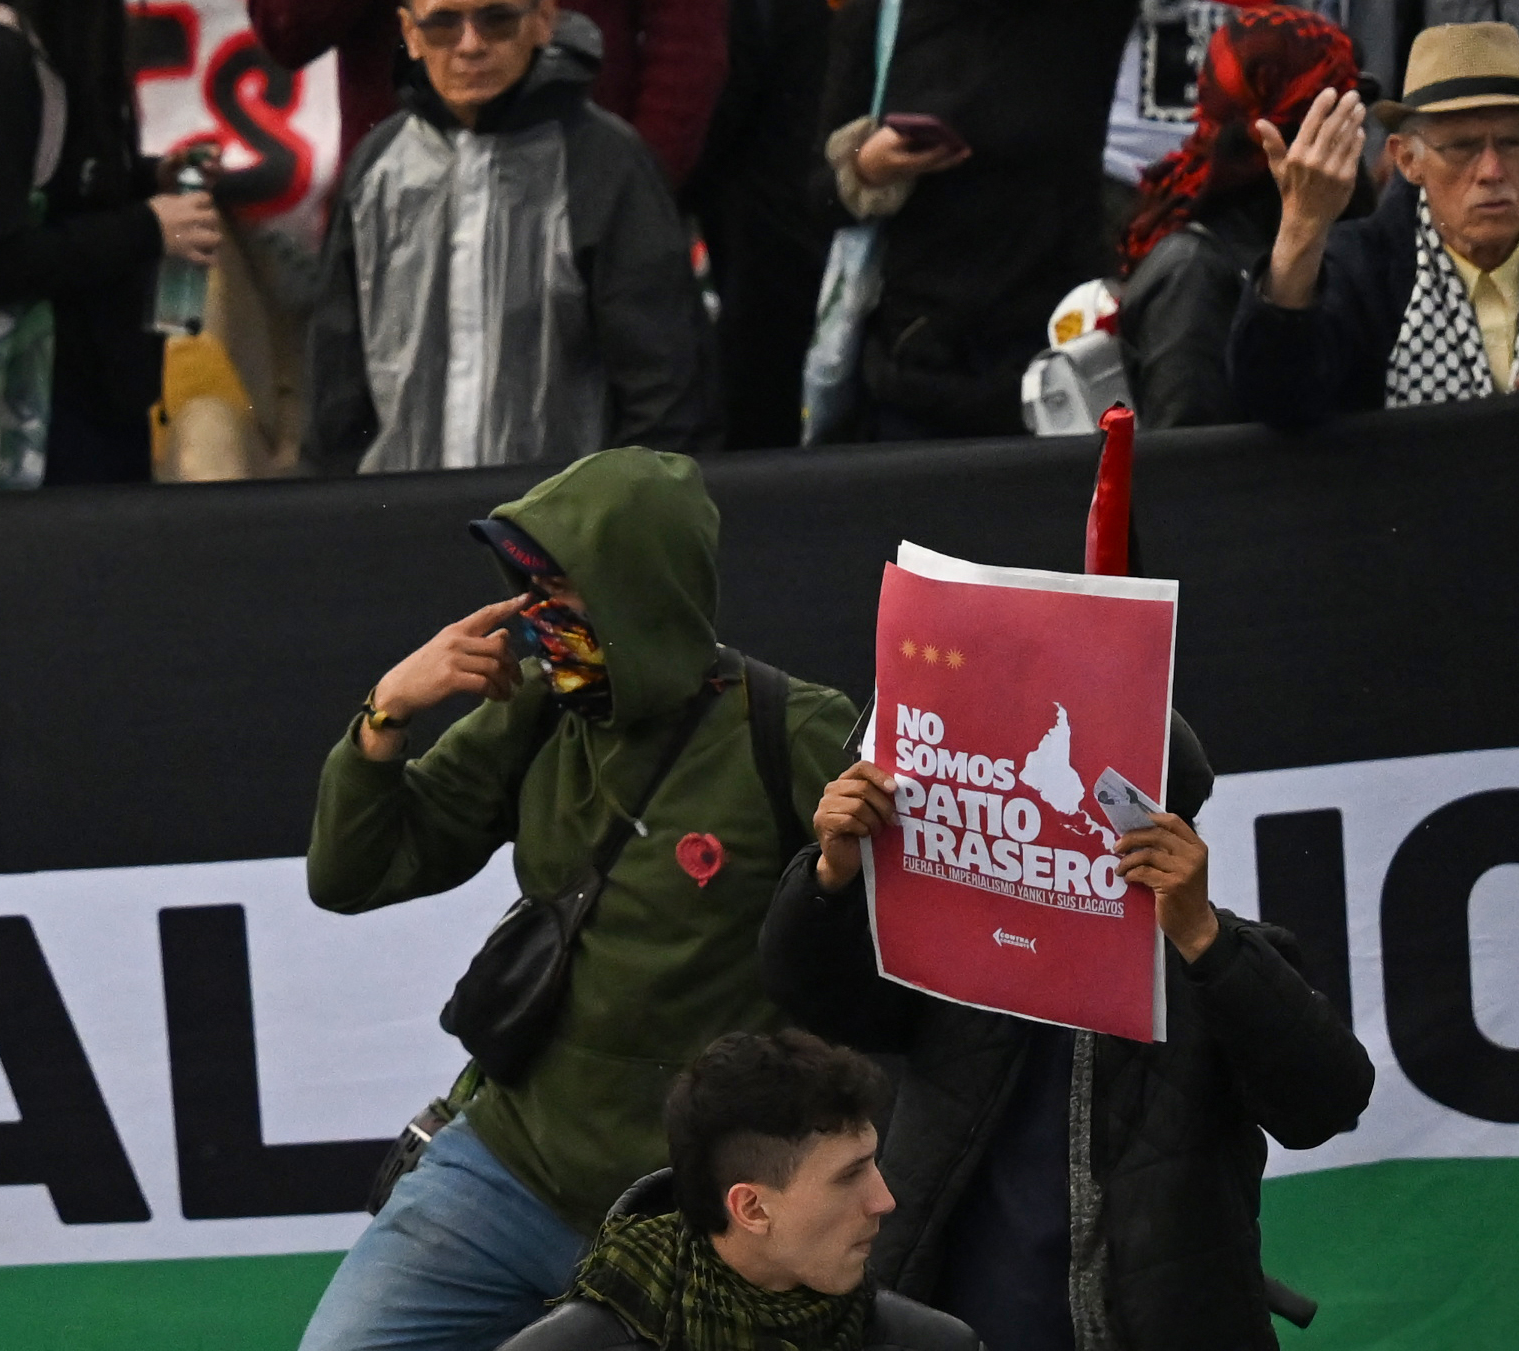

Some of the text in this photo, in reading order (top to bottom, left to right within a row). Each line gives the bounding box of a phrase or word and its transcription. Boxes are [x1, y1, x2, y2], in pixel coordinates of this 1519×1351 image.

[895, 702, 945, 745] NO
[894, 739, 1016, 792] SOMOS
[893, 772, 1042, 843] PATIO
[898, 816, 1129, 901] TRASERO
[903, 855, 934, 875] FUERA
[935, 864, 948, 879] EL
[948, 866, 1016, 896] IMPERIALISMO
[1017, 885, 1047, 904] YANKI
[1056, 893, 1078, 910] SUS
[1078, 895, 1125, 916] LACAYOS
